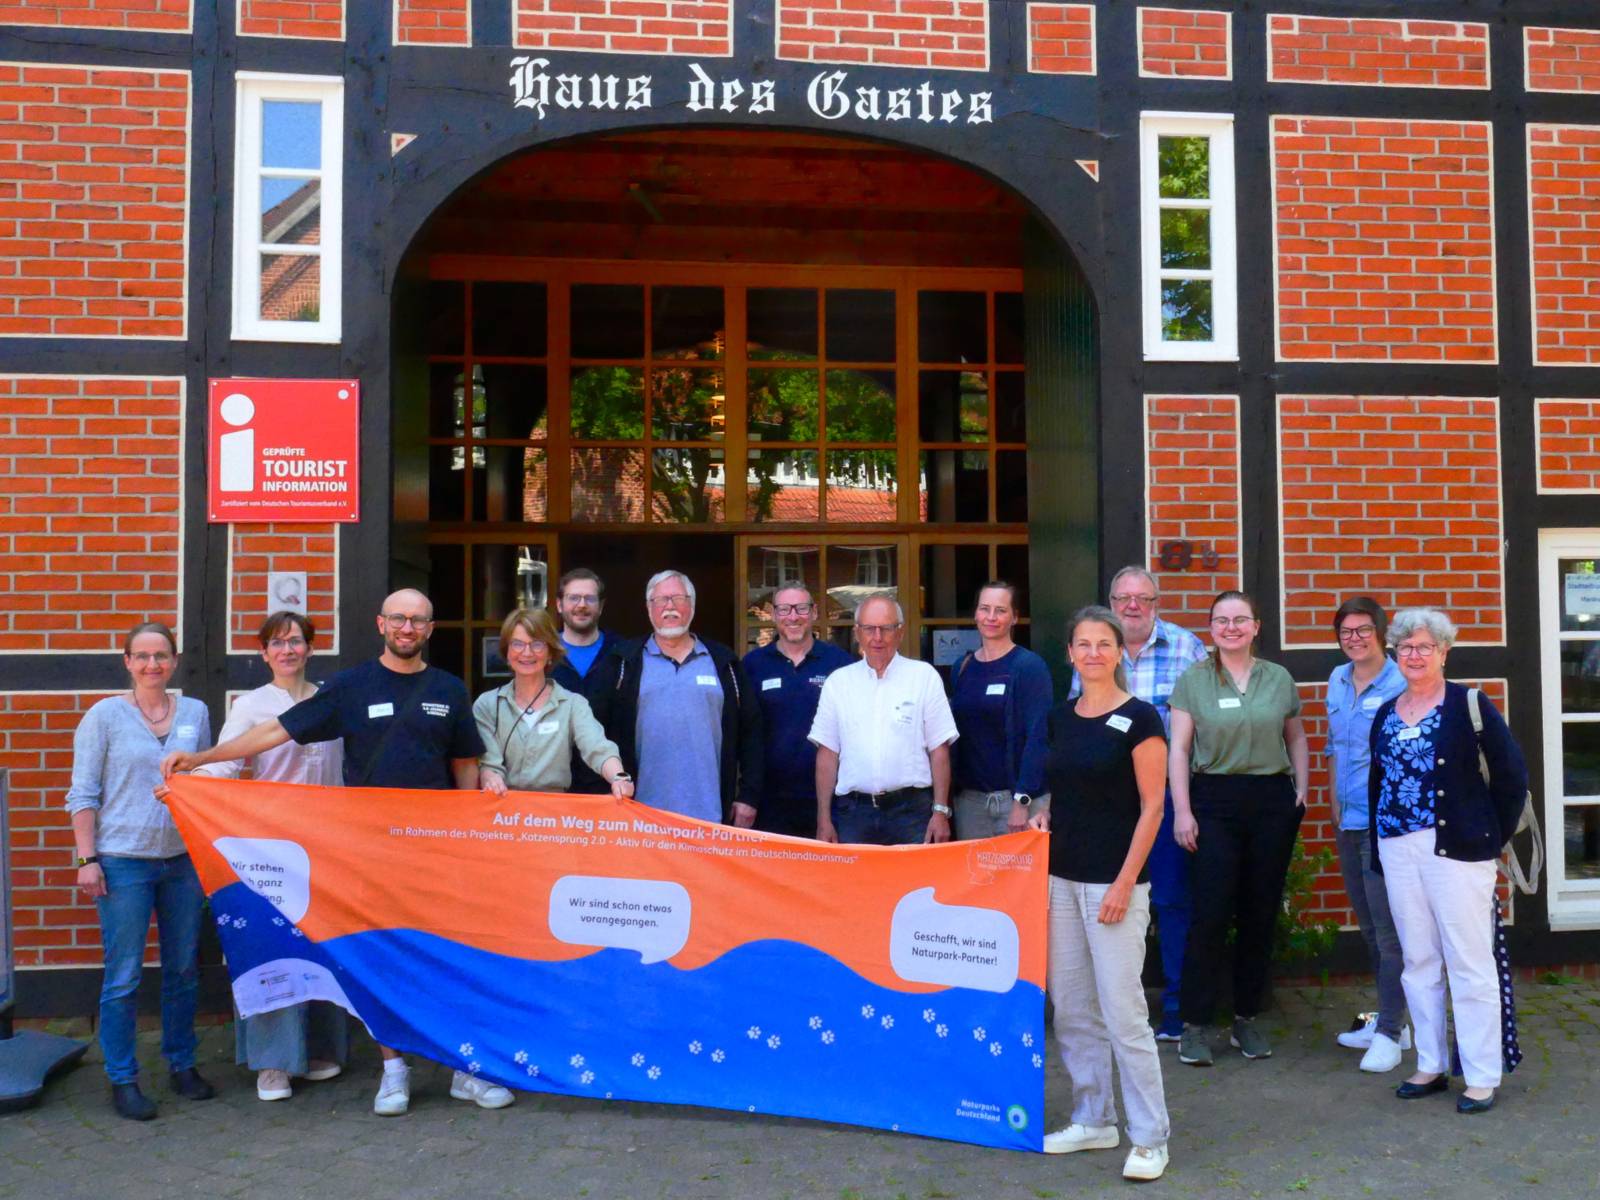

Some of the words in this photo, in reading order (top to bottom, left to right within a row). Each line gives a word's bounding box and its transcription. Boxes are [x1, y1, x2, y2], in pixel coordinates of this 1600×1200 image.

[508, 55, 653, 120] Haus
[686, 63, 776, 113] des
[807, 70, 994, 124] Gastes
[262, 447, 305, 457] GEPRÜFTE
[262, 460, 348, 477] TOURIST
[262, 481, 347, 492] INFORMATION
[493, 812, 521, 826] Auf
[523, 813, 557, 828] dem
[561, 815, 594, 833] Weg
[598, 819, 629, 832] zum
[405, 826, 447, 838] Rahmen
[449, 828, 467, 839] des
[469, 829, 514, 842] Projektes
[591, 835, 606, 846] 2.0
[616, 837, 640, 848] Aktiv
[641, 838, 656, 849] für
[657, 840, 676, 850] den
[736, 846, 748, 857] im
[250, 863, 285, 873] stehen
[257, 879, 283, 889] ganz
[569, 898, 586, 908] Wir
[589, 898, 609, 909] sind
[612, 901, 641, 911] schon
[643, 903, 672, 913] etwas
[580, 915, 659, 928] vorangegangen.
[913, 931, 960, 946] Geschafft,
[962, 937, 976, 947] wir
[978, 938, 997, 950] sind
[911, 947, 998, 966] Naturpark-Partner!
[956, 1108, 1001, 1122] Deutschland
